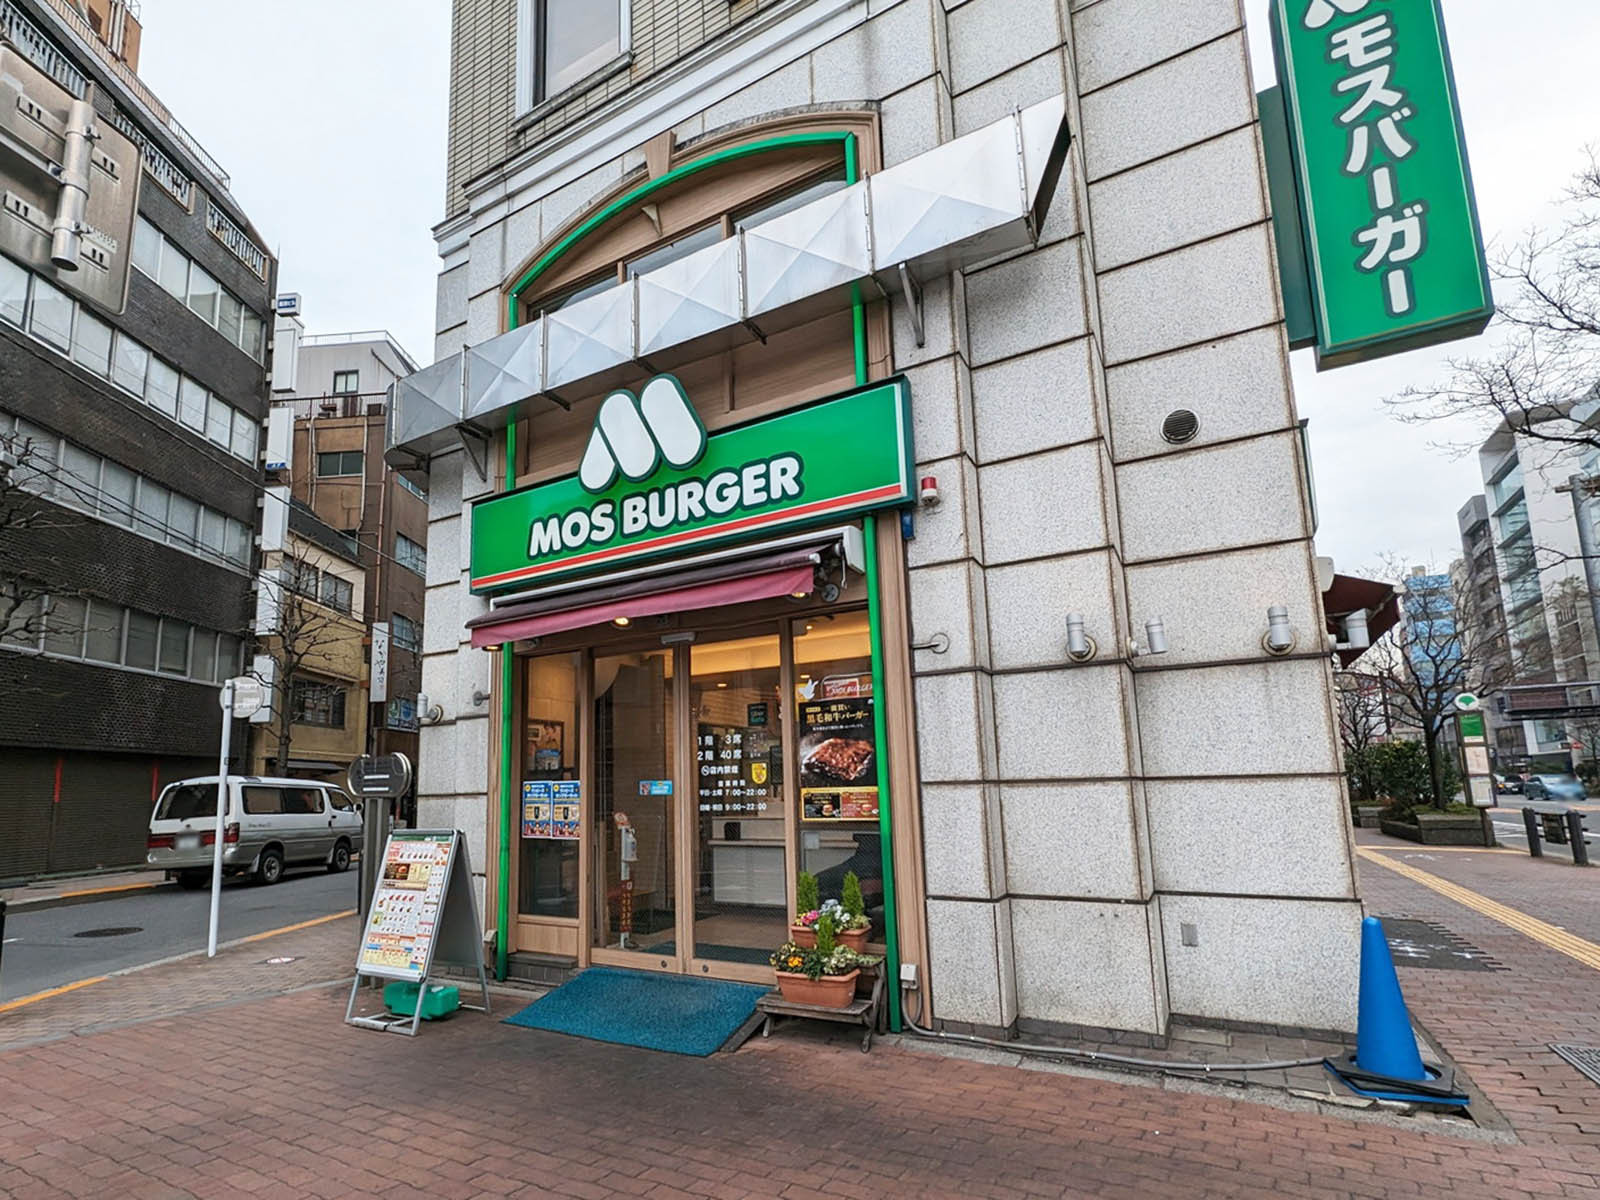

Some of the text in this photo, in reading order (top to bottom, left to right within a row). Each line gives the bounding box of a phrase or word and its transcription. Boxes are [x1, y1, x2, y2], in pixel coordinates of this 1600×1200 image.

[1330, 15, 1423, 314] モスバーガー
[529, 457, 801, 557] MOS BURGER
